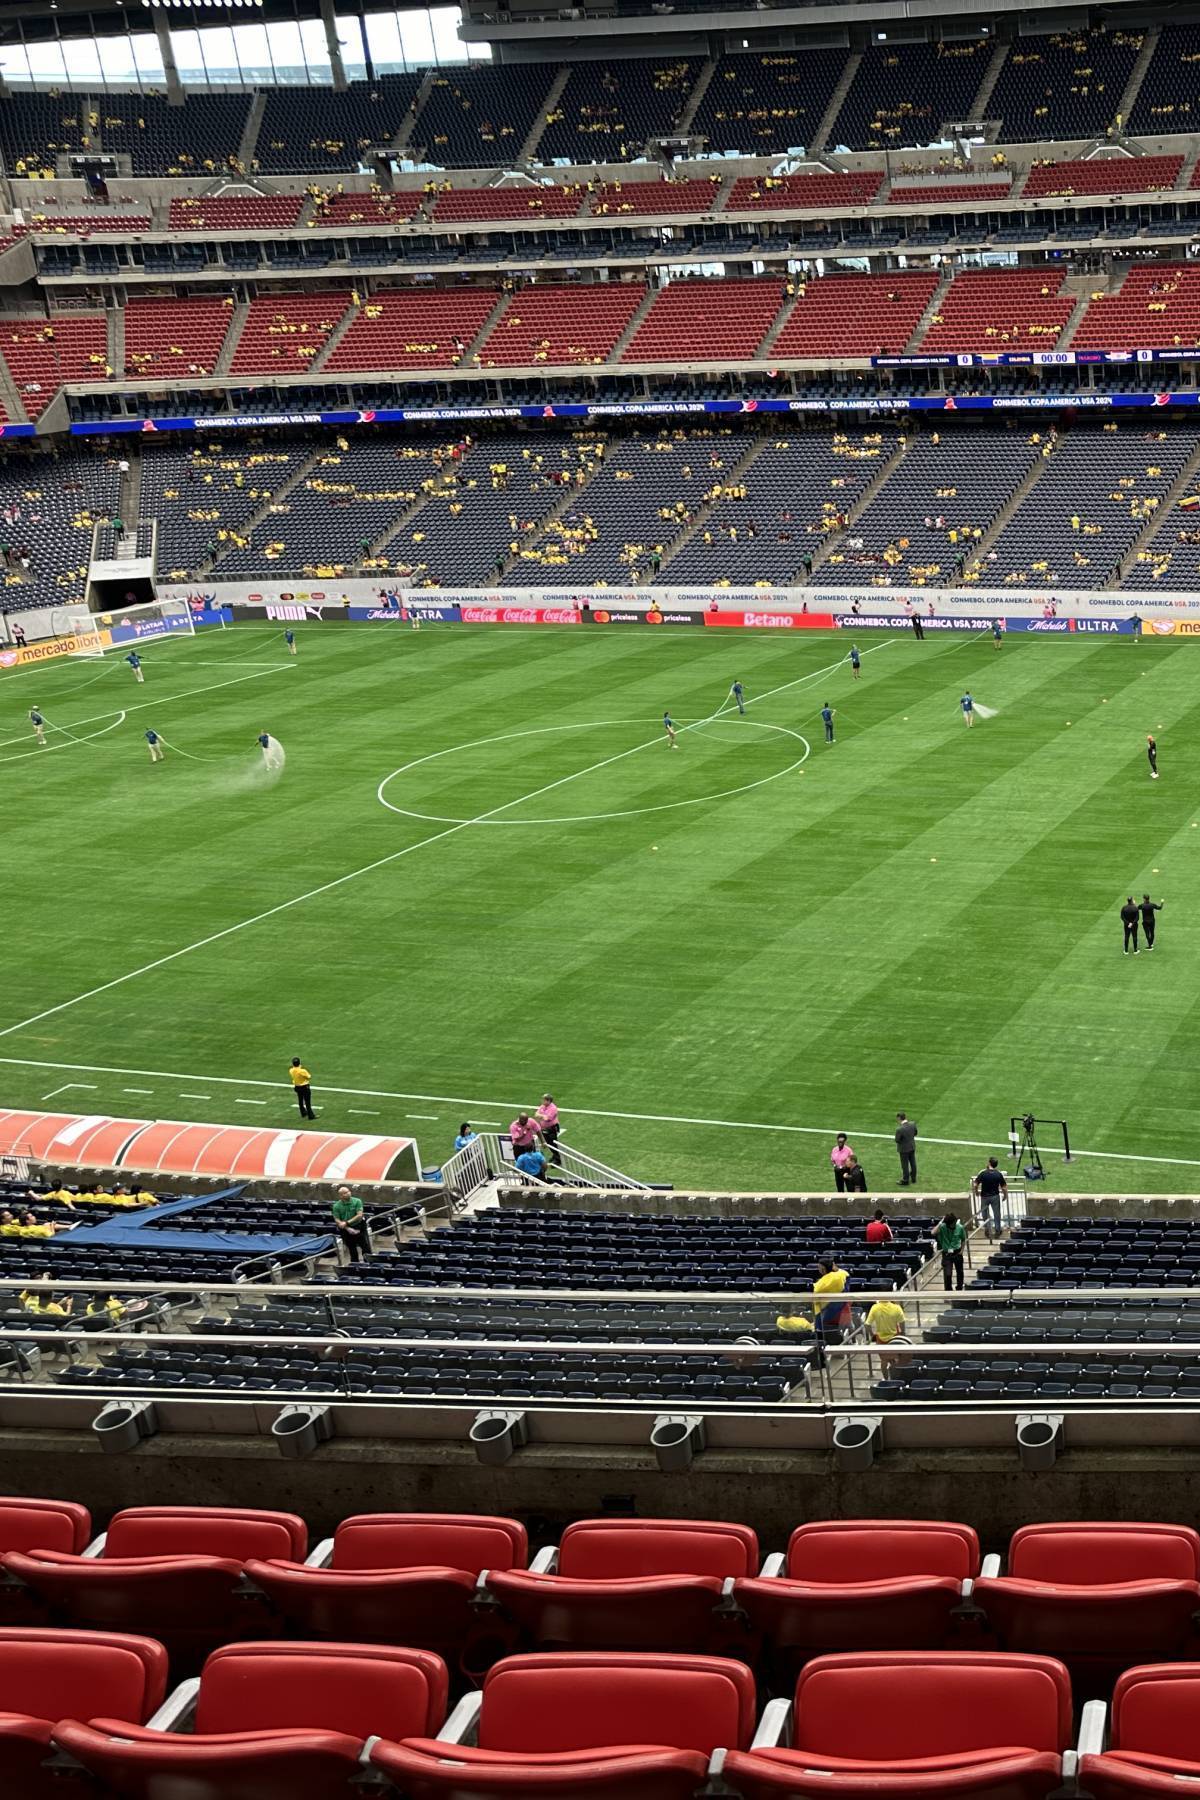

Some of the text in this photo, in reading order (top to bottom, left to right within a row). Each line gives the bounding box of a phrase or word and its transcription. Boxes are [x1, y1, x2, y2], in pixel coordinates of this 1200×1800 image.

[790, 401, 828, 409] CONMEBOL
[848, 401, 878, 409] AMERICA
[992, 398, 1030, 406] CONMEBOL
[1050, 398, 1080, 406] AMERICA
[403, 408, 521, 419] CONMEBOL COPA AMERICA USA 2024
[588, 405, 625, 414] CONMEBOL
[626, 405, 643, 413] COPA
[644, 404, 674, 412] AMERICA
[688, 403, 704, 411] 2024
[194, 414, 321, 427] CONMEBOL COPA AMERICA USA 2024
[266, 606, 306, 620] PUMA
[367, 610, 400, 619] Michelob
[744, 613, 793, 626] Betano
[844, 617, 992, 628] CONMEBOL COPA MERICA USA 2024
[1027, 620, 1118, 631] Michelob ULTRA
[22, 640, 75, 660] mercado
